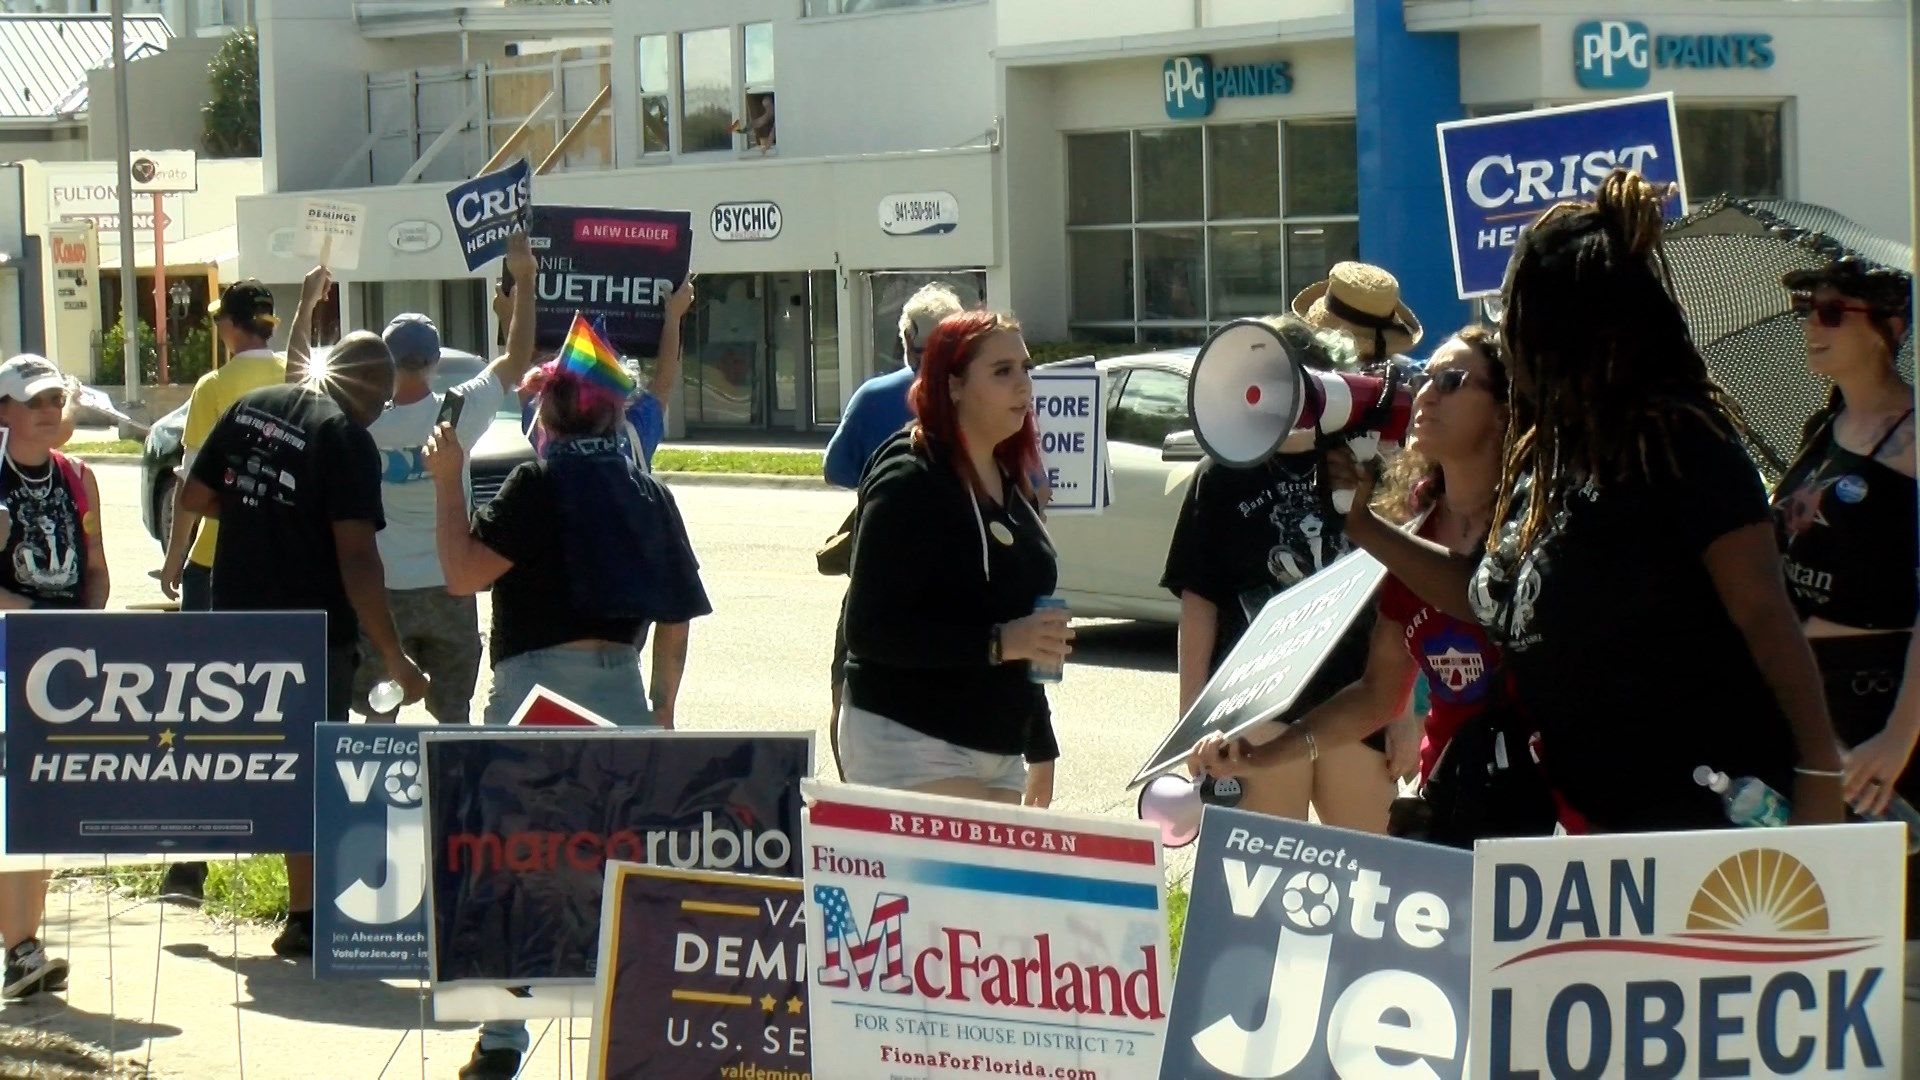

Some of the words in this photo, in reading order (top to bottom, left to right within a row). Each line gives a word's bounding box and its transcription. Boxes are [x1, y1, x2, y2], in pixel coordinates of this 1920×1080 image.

[1583, 22, 1648, 76] PPG
[1655, 33, 1776, 70] PAINTS
[1165, 57, 1206, 108] PPG
[1213, 61, 1293, 98] PAINTS
[54, 185, 121, 201] FULTON
[1467, 145, 1658, 208] CRIST
[308, 208, 357, 222] DEMINGS
[456, 176, 528, 229] CRIS
[715, 206, 778, 232] PSYCHIC
[582, 225, 590, 236] A
[594, 226, 621, 238] NEW
[625, 228, 669, 240] LEADER
[541, 256, 577, 272] NIEL
[536, 273, 674, 305] UETHER
[1034, 396, 1089, 417] FORE
[1041, 432, 1085, 453] ONE
[1403, 608, 1429, 650] ORT
[26, 647, 306, 723] CRIST
[30, 747, 299, 782] HERNÁNDEZ
[336, 737, 418, 754] Re-Elec
[335, 760, 422, 804] vo
[646, 811, 792, 869] rubio
[889, 813, 1077, 853] REPUBLICAN
[1226, 828, 1347, 869] Re-Elect
[1347, 859, 1360, 872] &
[812, 845, 887, 879] Fiona
[765, 897, 807, 928] VA
[1222, 857, 1451, 949] vote
[1493, 857, 1656, 943] DAN
[674, 932, 808, 982] DEMI
[814, 884, 1166, 1021] McFarland
[1191, 925, 1458, 1080] Je
[1489, 966, 1886, 1080] LOBECK
[667, 1017, 743, 1051] U.S.
[855, 1013, 889, 1032] FOR
[895, 1017, 950, 1038] STATE
[957, 1024, 1016, 1045] HOUSE
[1023, 1031, 1108, 1054] DISTRICT
[1115, 1039, 1136, 1056] 72
[720, 1062, 812, 1080] valdeming
[879, 1044, 1097, 1080] FionaForFlorida.com
